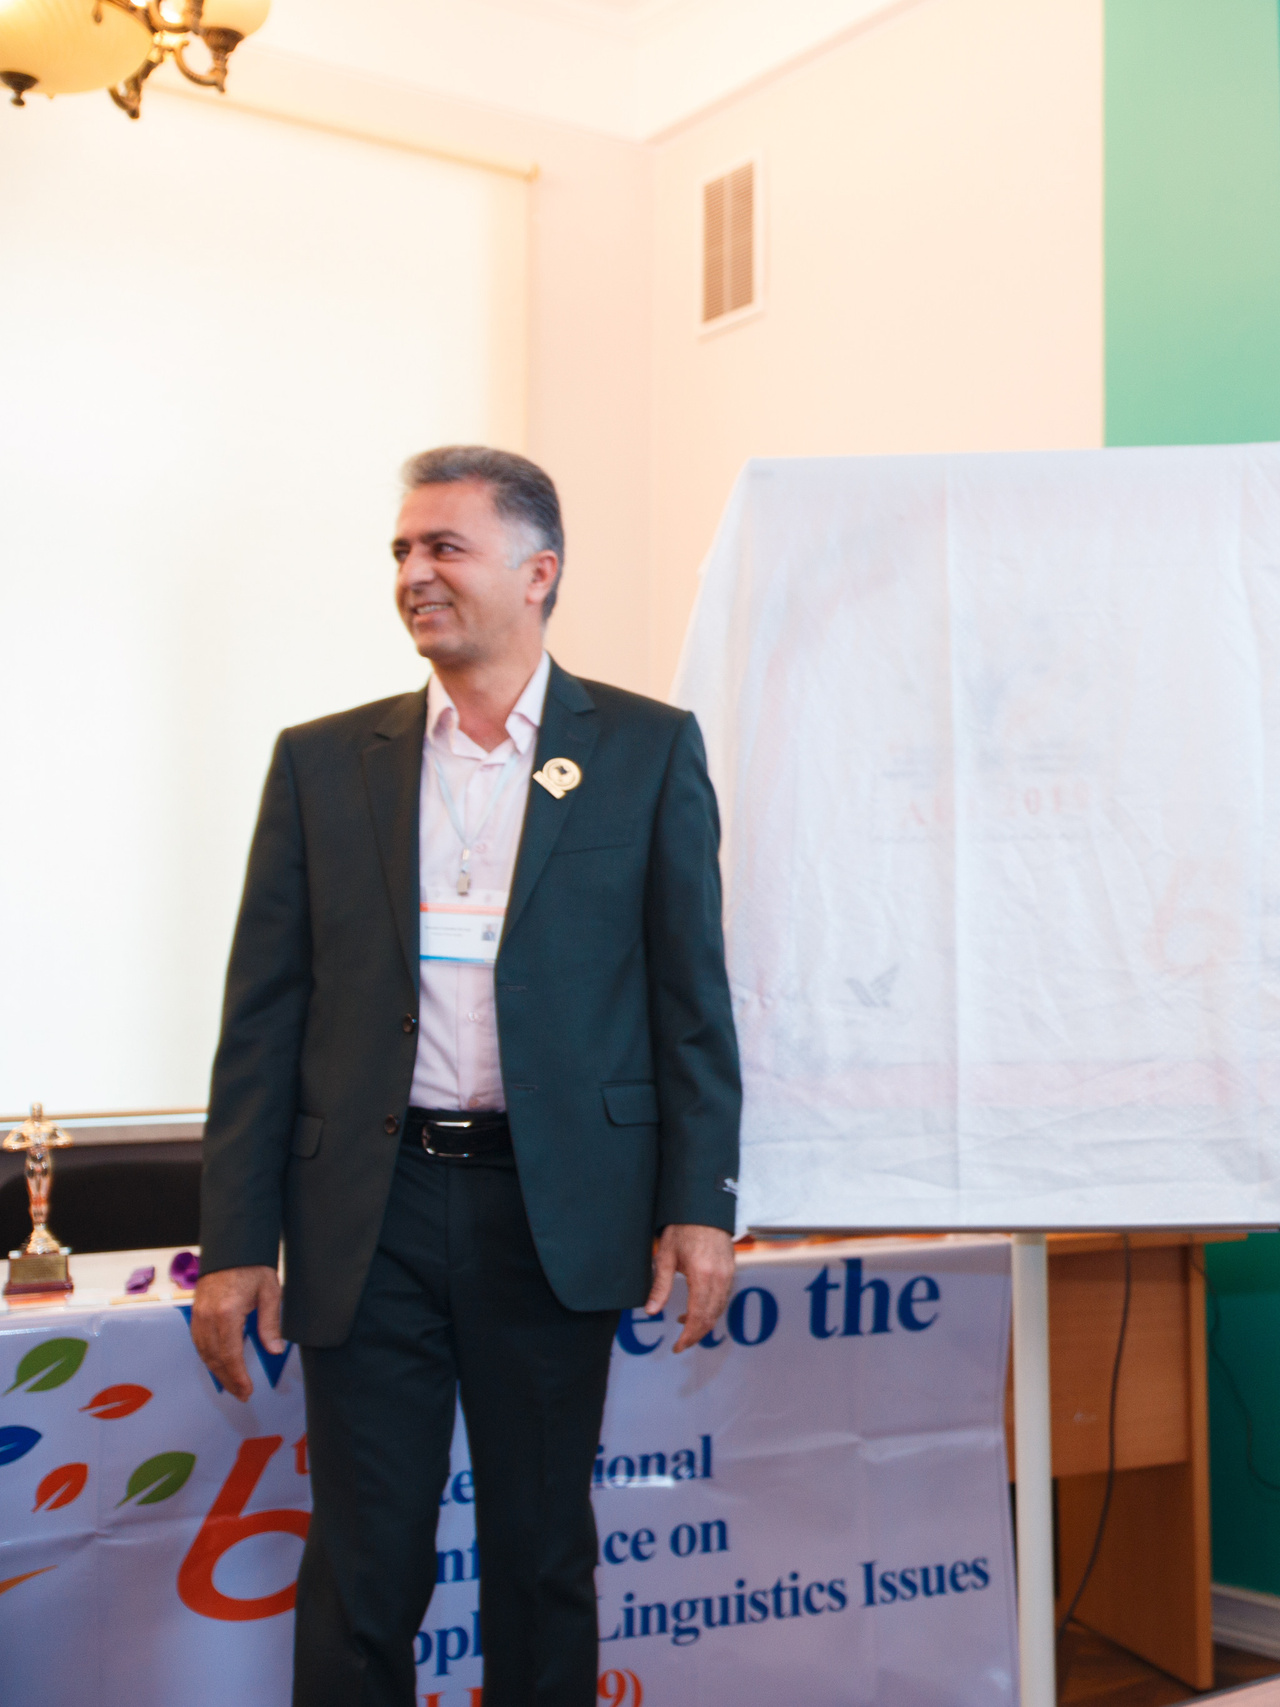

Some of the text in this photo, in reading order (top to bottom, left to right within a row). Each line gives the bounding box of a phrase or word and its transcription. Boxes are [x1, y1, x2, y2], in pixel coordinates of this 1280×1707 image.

[698, 1286, 779, 1348] o
[804, 1257, 941, 1340] the
[669, 1518, 729, 1558] on
[858, 1556, 990, 1609] Issues
